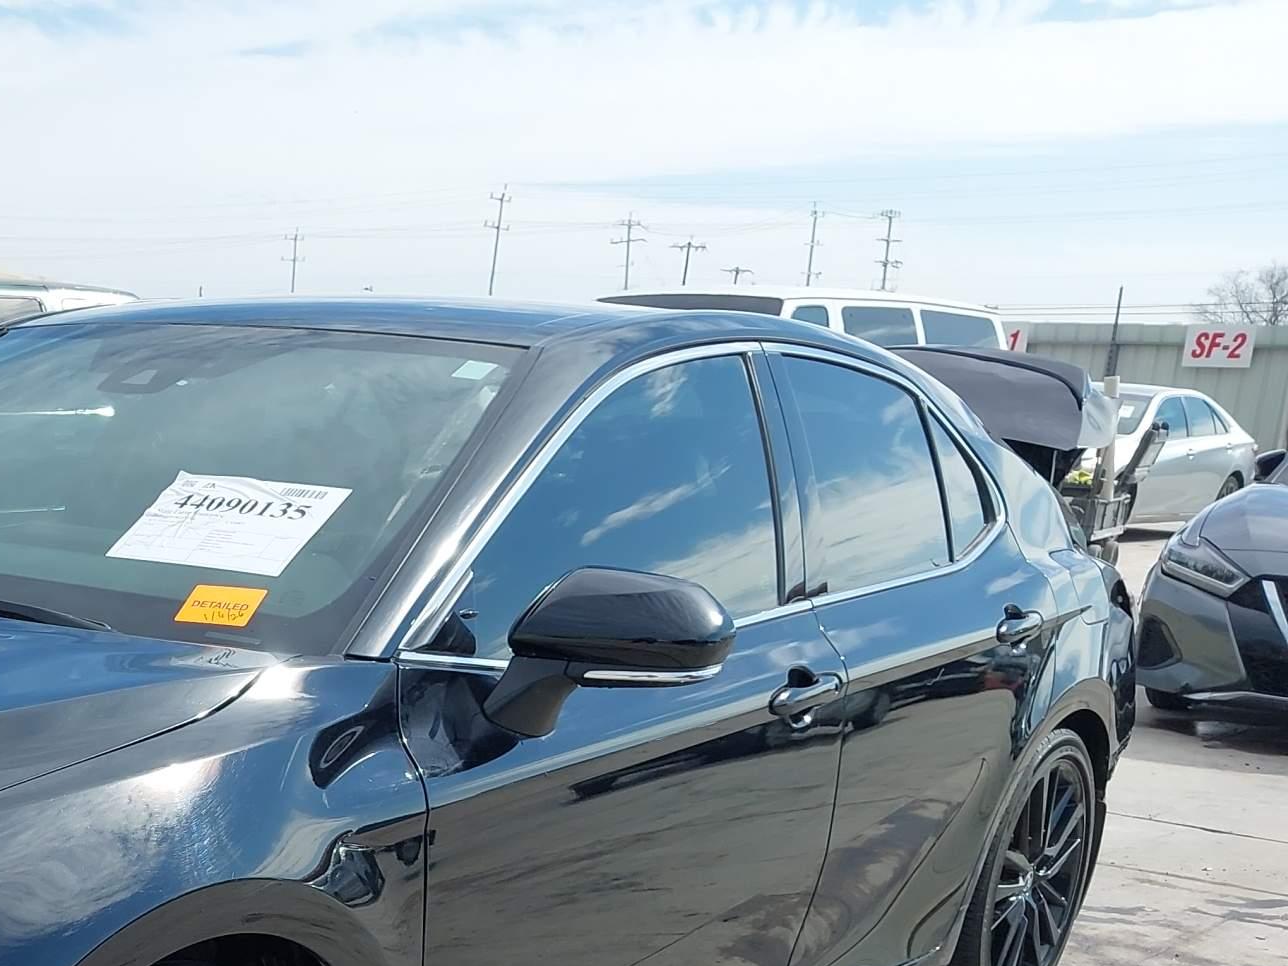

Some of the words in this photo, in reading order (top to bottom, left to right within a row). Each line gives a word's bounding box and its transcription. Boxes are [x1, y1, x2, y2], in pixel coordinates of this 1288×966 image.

[1191, 332, 1248, 359] SF-2
[173, 493, 312, 521] 44090135
[191, 600, 249, 611] DETAILED
